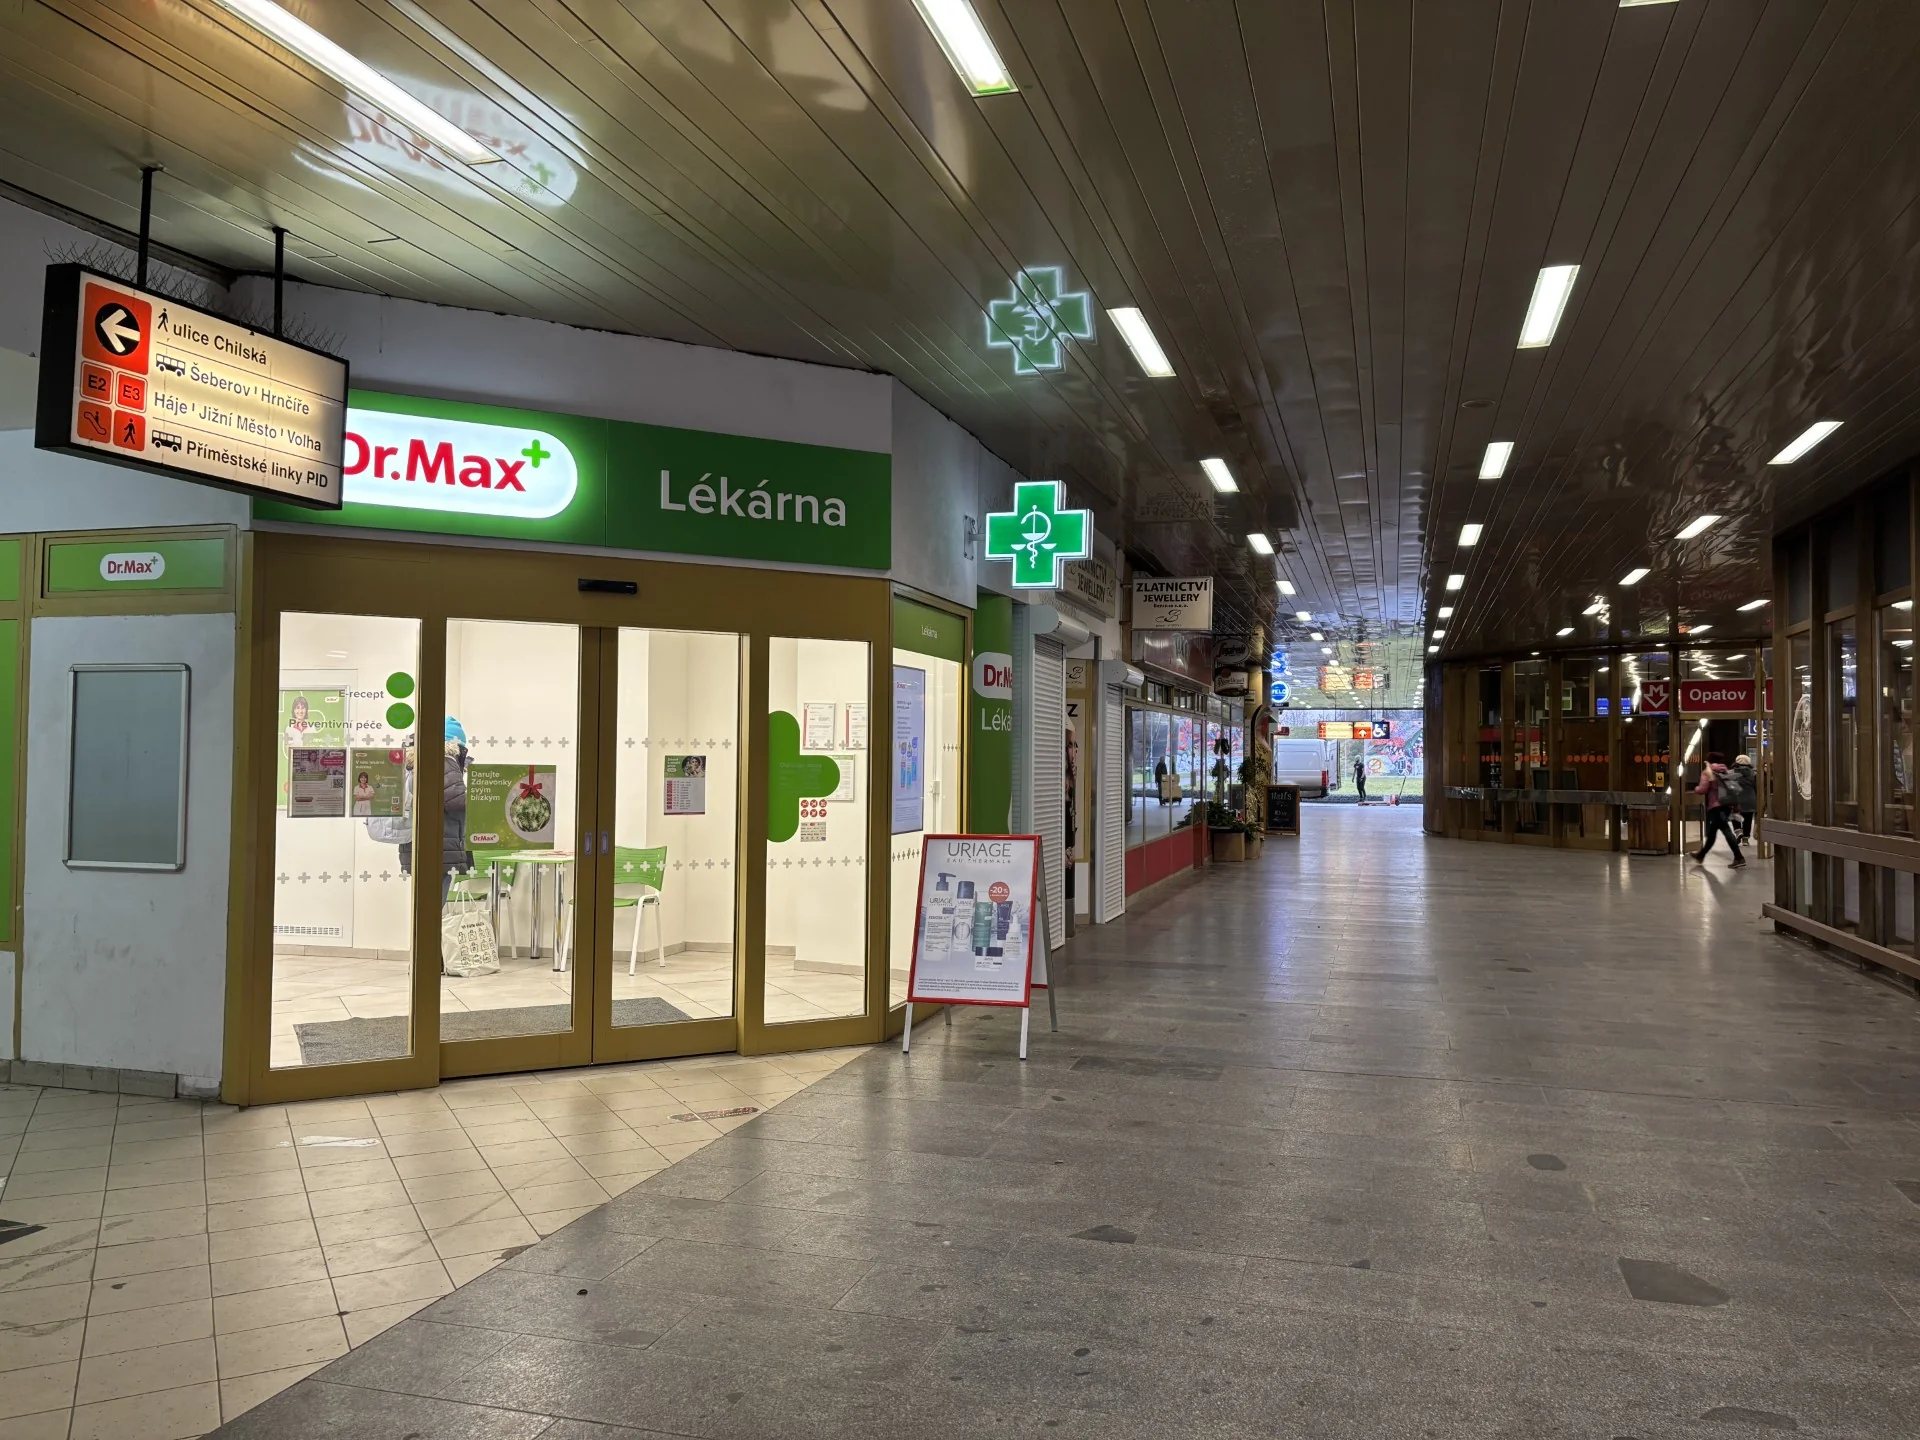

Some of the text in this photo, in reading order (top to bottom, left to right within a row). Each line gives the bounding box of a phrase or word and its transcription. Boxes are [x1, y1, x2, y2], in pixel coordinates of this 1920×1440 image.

[173, 324, 267, 365] ulice Chilská
[88, 374, 107, 392] E2
[190, 362, 310, 415] Šeberov Hrnčíře
[122, 384, 141, 401] E3
[154, 392, 321, 451] Háje Jižní Město Volha
[187, 440, 328, 488] Příměstské linky PID
[661, 470, 846, 527] Lékárna
[1136, 579, 1209, 592] ZLATNICTVÍ
[1143, 594, 1200, 602] JEWELLERY
[339, 690, 384, 700] E-recept
[1689, 688, 1747, 703] Opatov
[289, 719, 383, 731] Preventivní péče
[471, 771, 500, 779] Darujte
[471, 779, 512, 787] Zdravonky
[948, 842, 1012, 858] URIAGE
